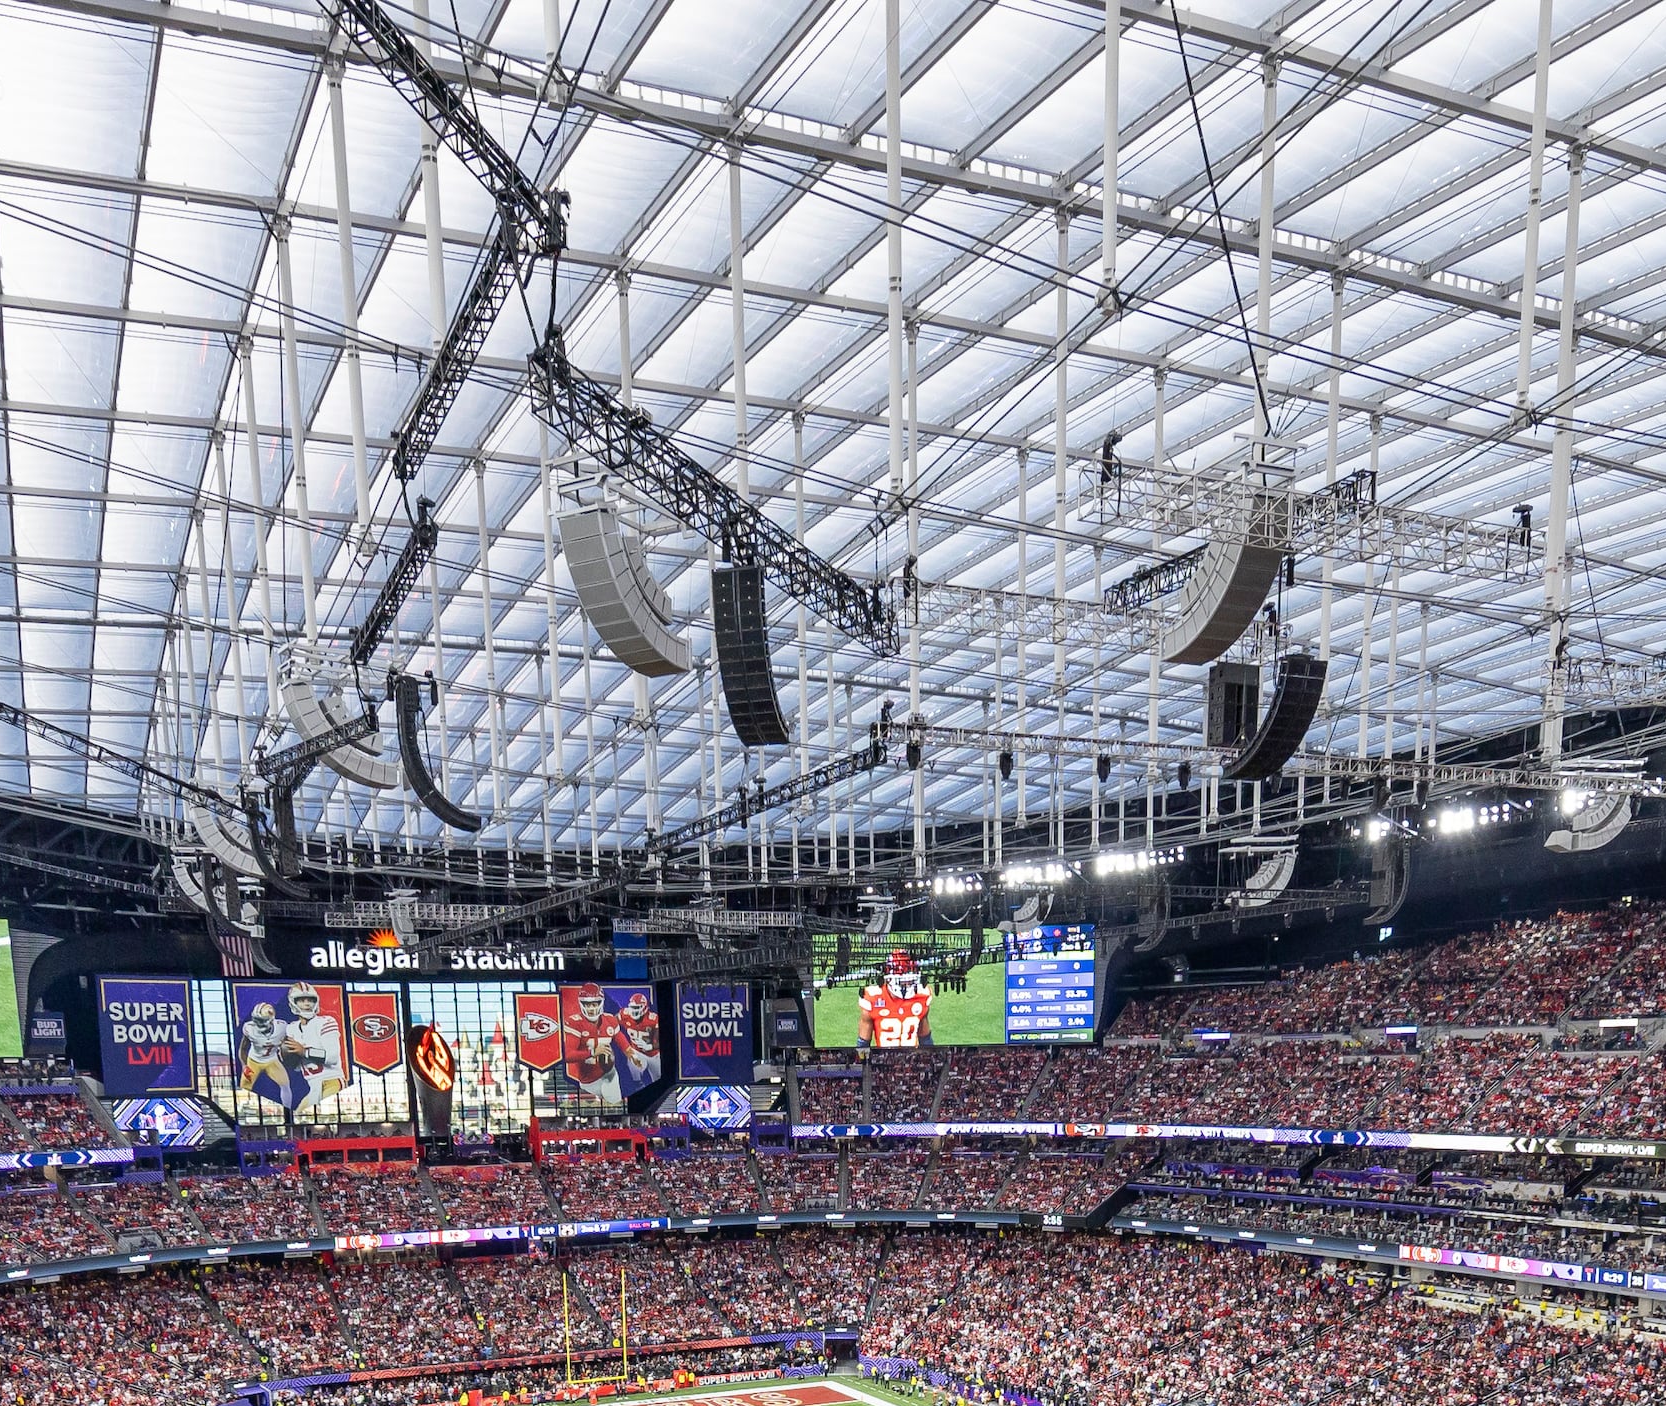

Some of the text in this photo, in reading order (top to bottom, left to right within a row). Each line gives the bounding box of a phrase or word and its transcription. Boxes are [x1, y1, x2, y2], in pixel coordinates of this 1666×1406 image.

[310, 940, 421, 975] allegia
[108, 1002, 184, 1021] SUPER
[682, 1002, 744, 1019] SUPER
[34, 1028, 62, 1036] LIGHT
[36, 1021, 58, 1029] BUD
[112, 1024, 185, 1043] BOWL
[685, 1021, 743, 1038] BOWL
[879, 1017, 921, 1048] 20
[126, 1046, 174, 1065] LVIII
[695, 1040, 732, 1057] LVIII
[1575, 1142, 1603, 1153] SUPER
[1607, 1143, 1634, 1154] BOWL
[1043, 1214, 1063, 1226] 3:55
[1602, 1271, 1624, 1283] 8:29
[699, 1375, 726, 1386] SUPER
[729, 1372, 754, 1383] BOWL
